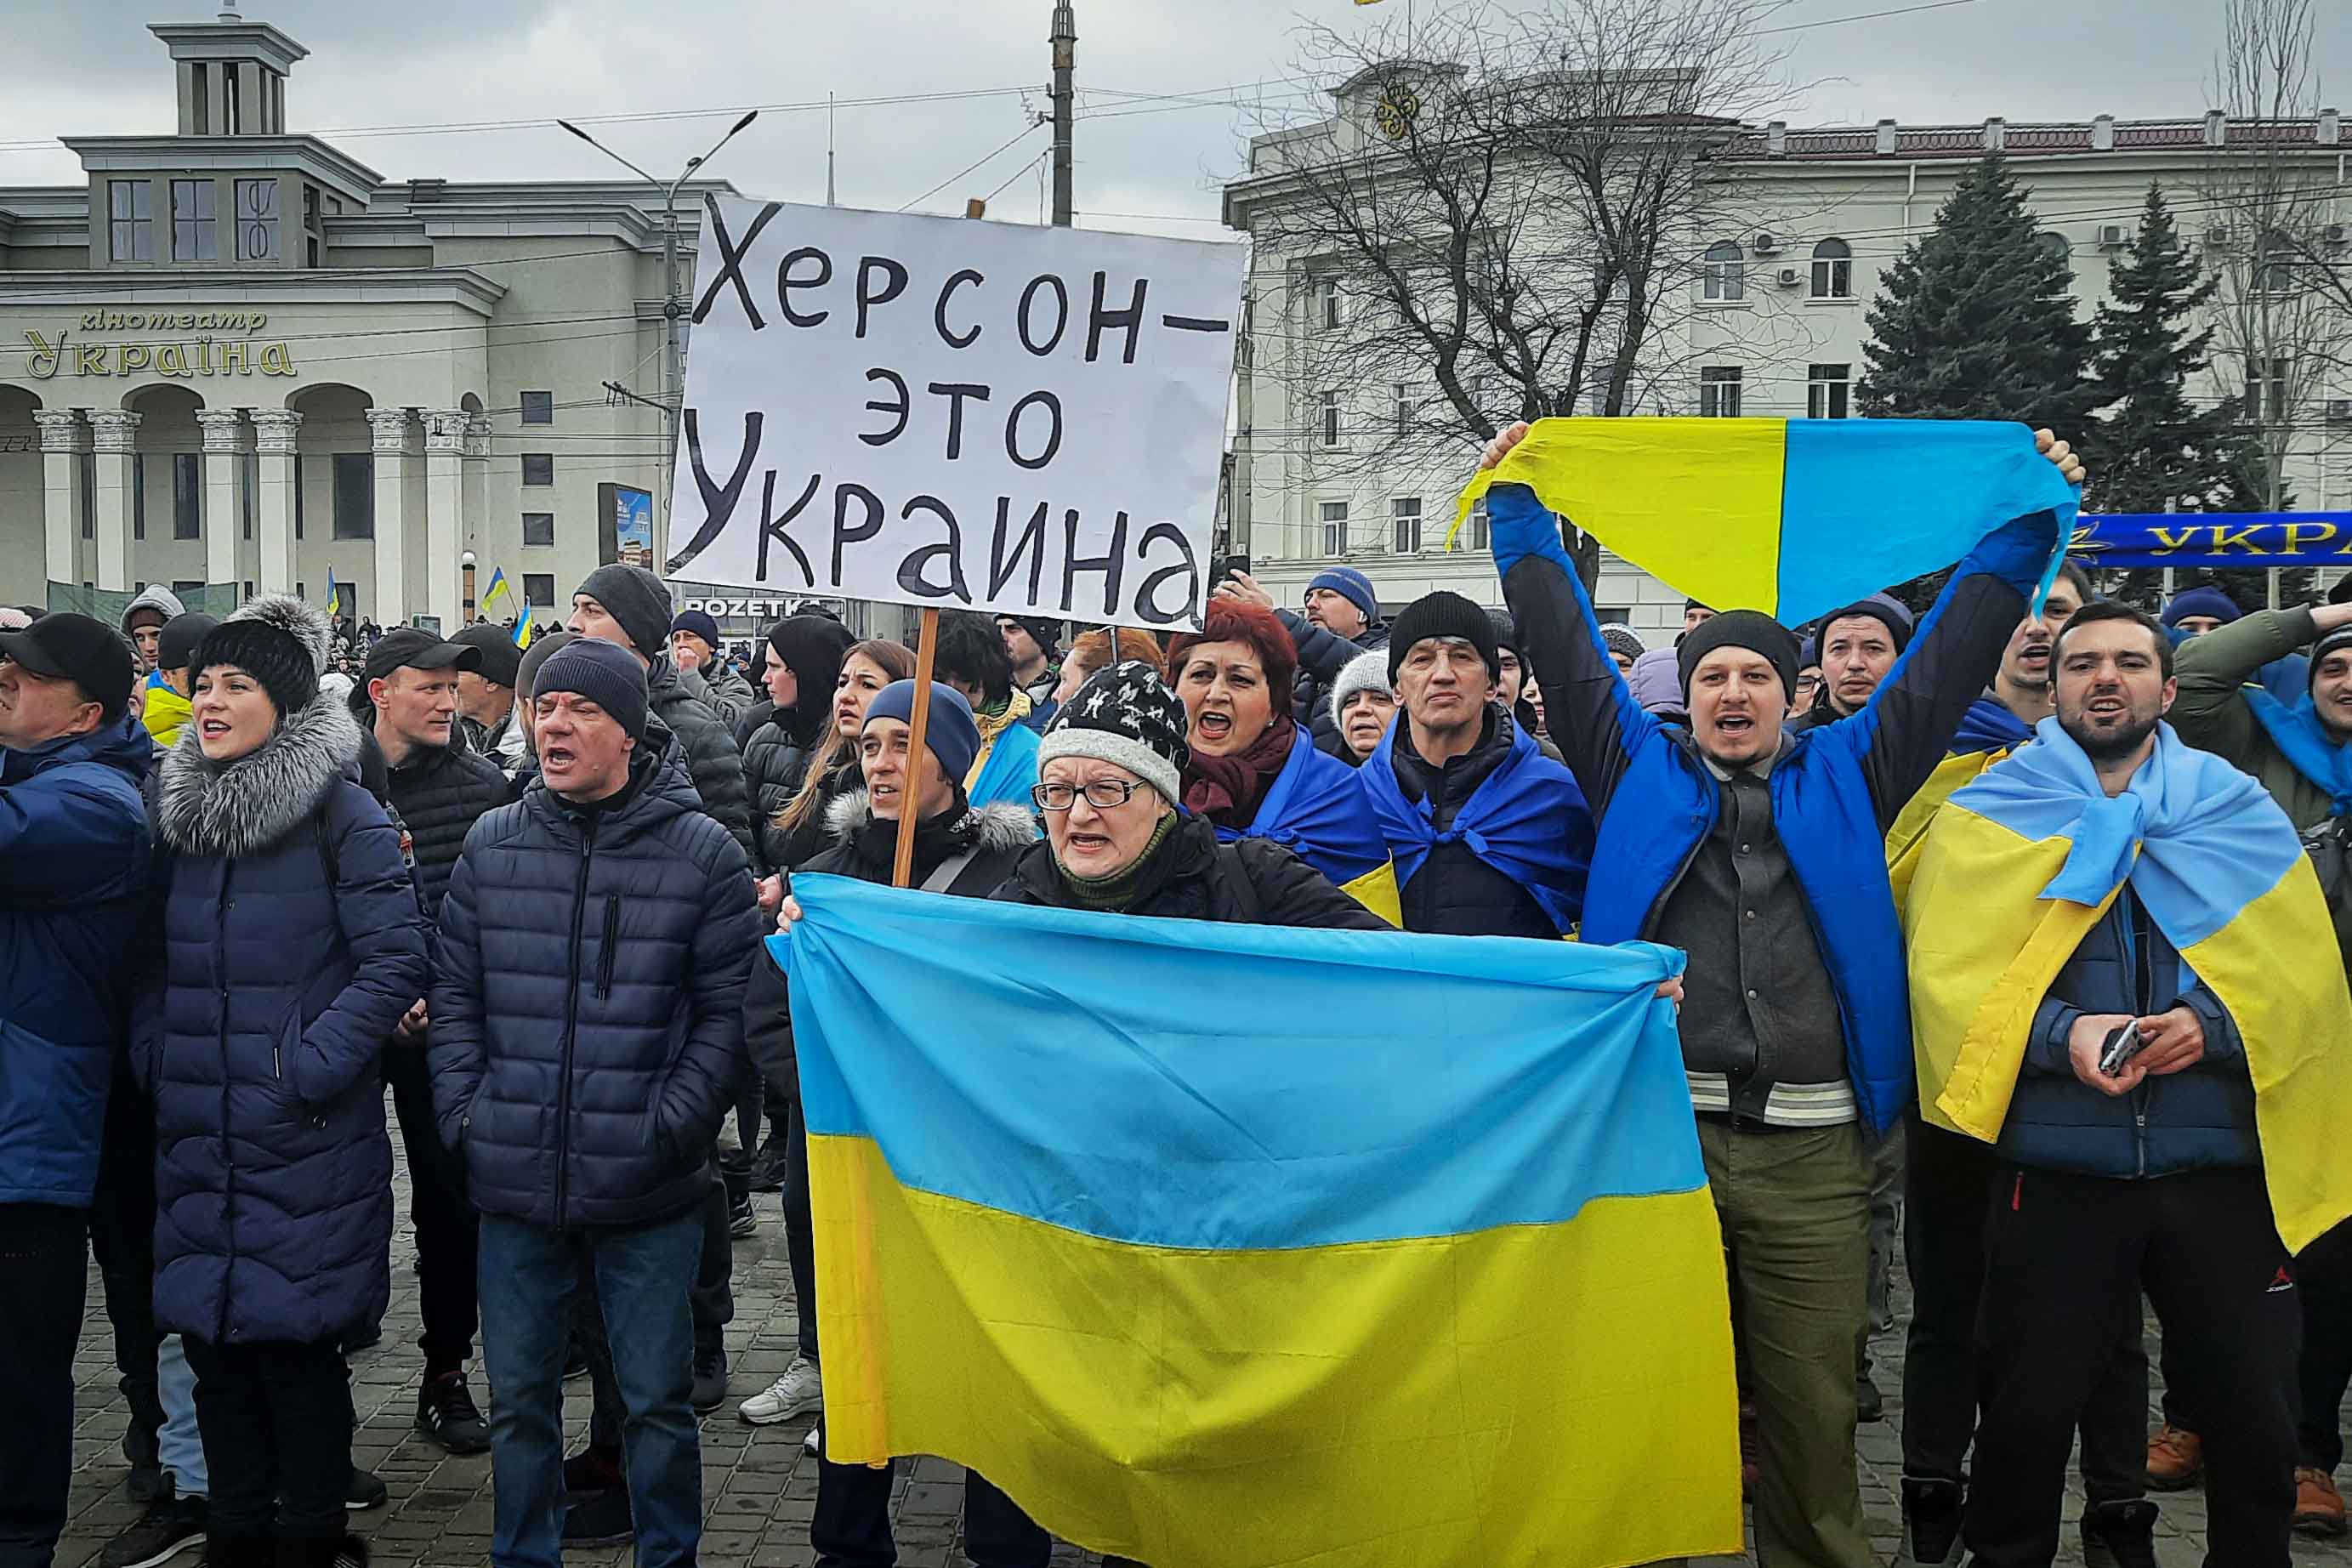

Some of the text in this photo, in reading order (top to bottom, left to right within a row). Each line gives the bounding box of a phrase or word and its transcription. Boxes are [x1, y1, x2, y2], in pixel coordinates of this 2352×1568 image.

[79, 308, 268, 335] кінотеатр
[24, 328, 298, 379] Україна
[857, 367, 1063, 469] это
[664, 408, 1204, 632] Украина
[2145, 521, 2352, 556] УКР
